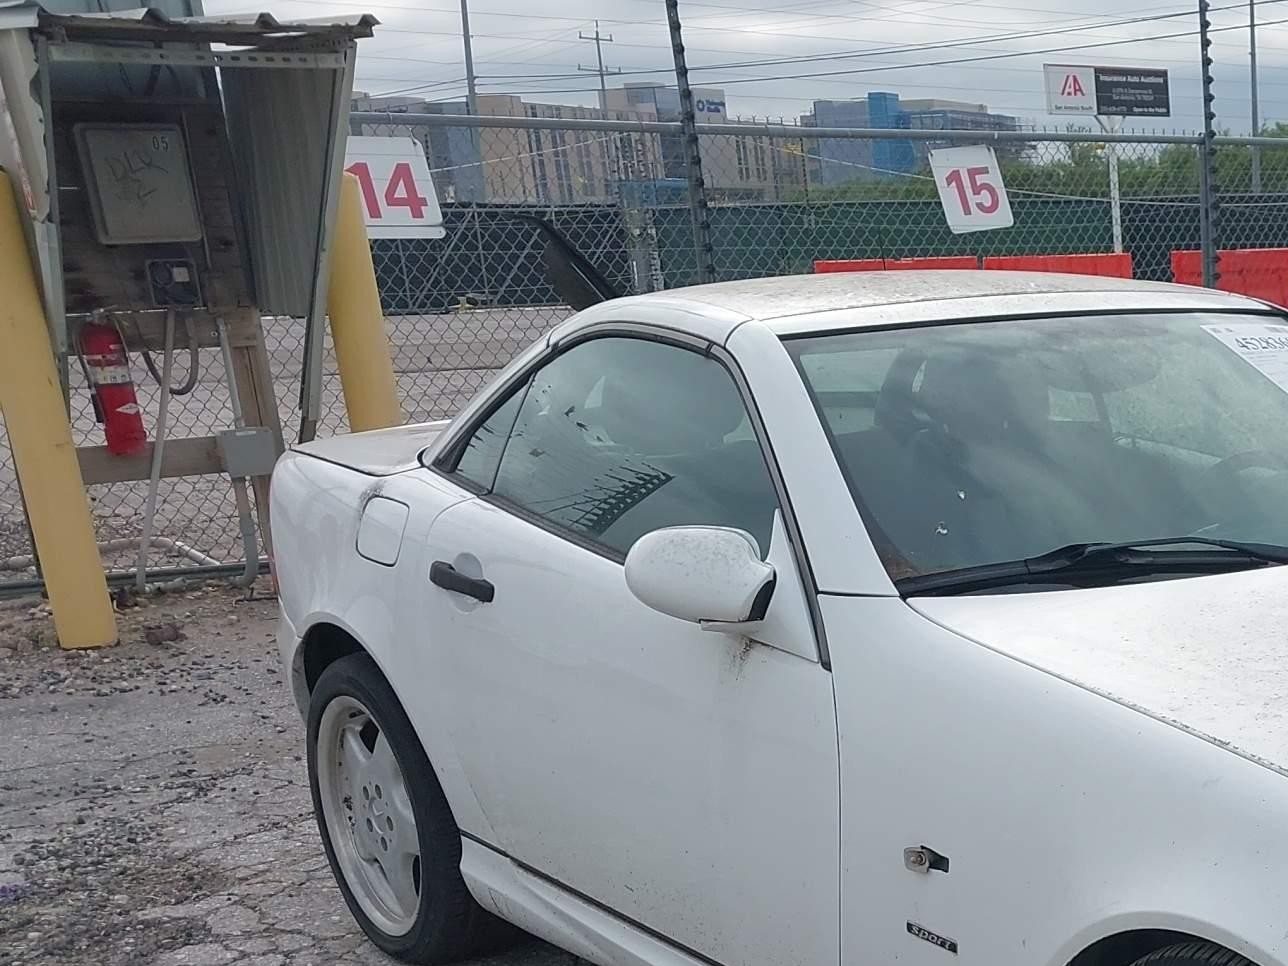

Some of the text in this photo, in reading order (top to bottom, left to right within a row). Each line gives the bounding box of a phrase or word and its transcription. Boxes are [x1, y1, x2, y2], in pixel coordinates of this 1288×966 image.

[152, 135, 168, 152] 05
[344, 163, 428, 219] 14
[945, 167, 999, 216] 15
